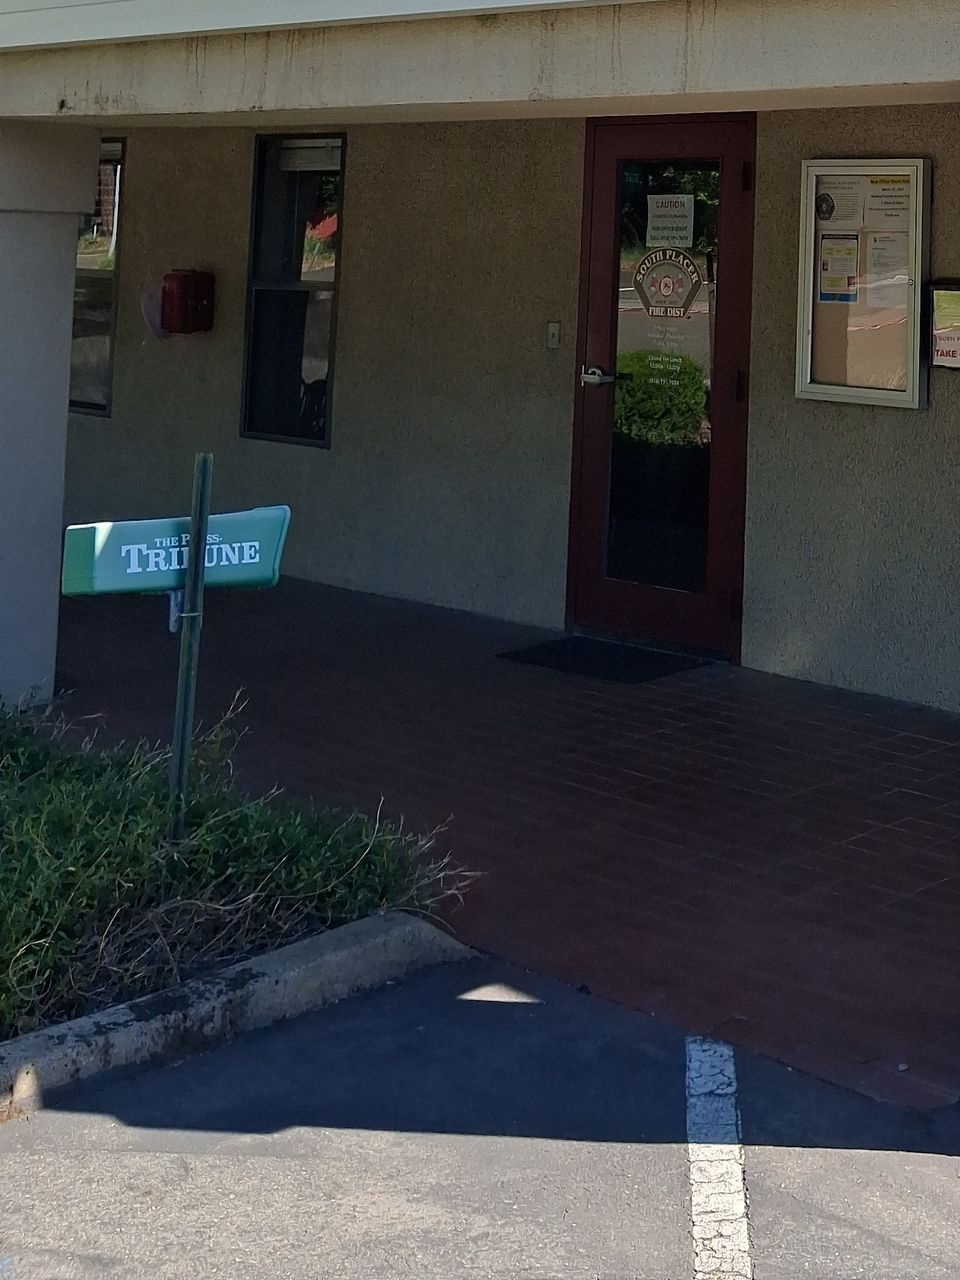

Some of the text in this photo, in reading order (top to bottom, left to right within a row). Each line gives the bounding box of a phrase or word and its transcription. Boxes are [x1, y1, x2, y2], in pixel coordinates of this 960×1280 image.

[656, 200, 686, 209] CAUTION
[636, 249, 699, 285] SOUTH PLACER
[649, 306, 684, 317] FIRE DIST
[935, 349, 957, 358] TAKE
[154, 533, 220, 547] THE PSS
